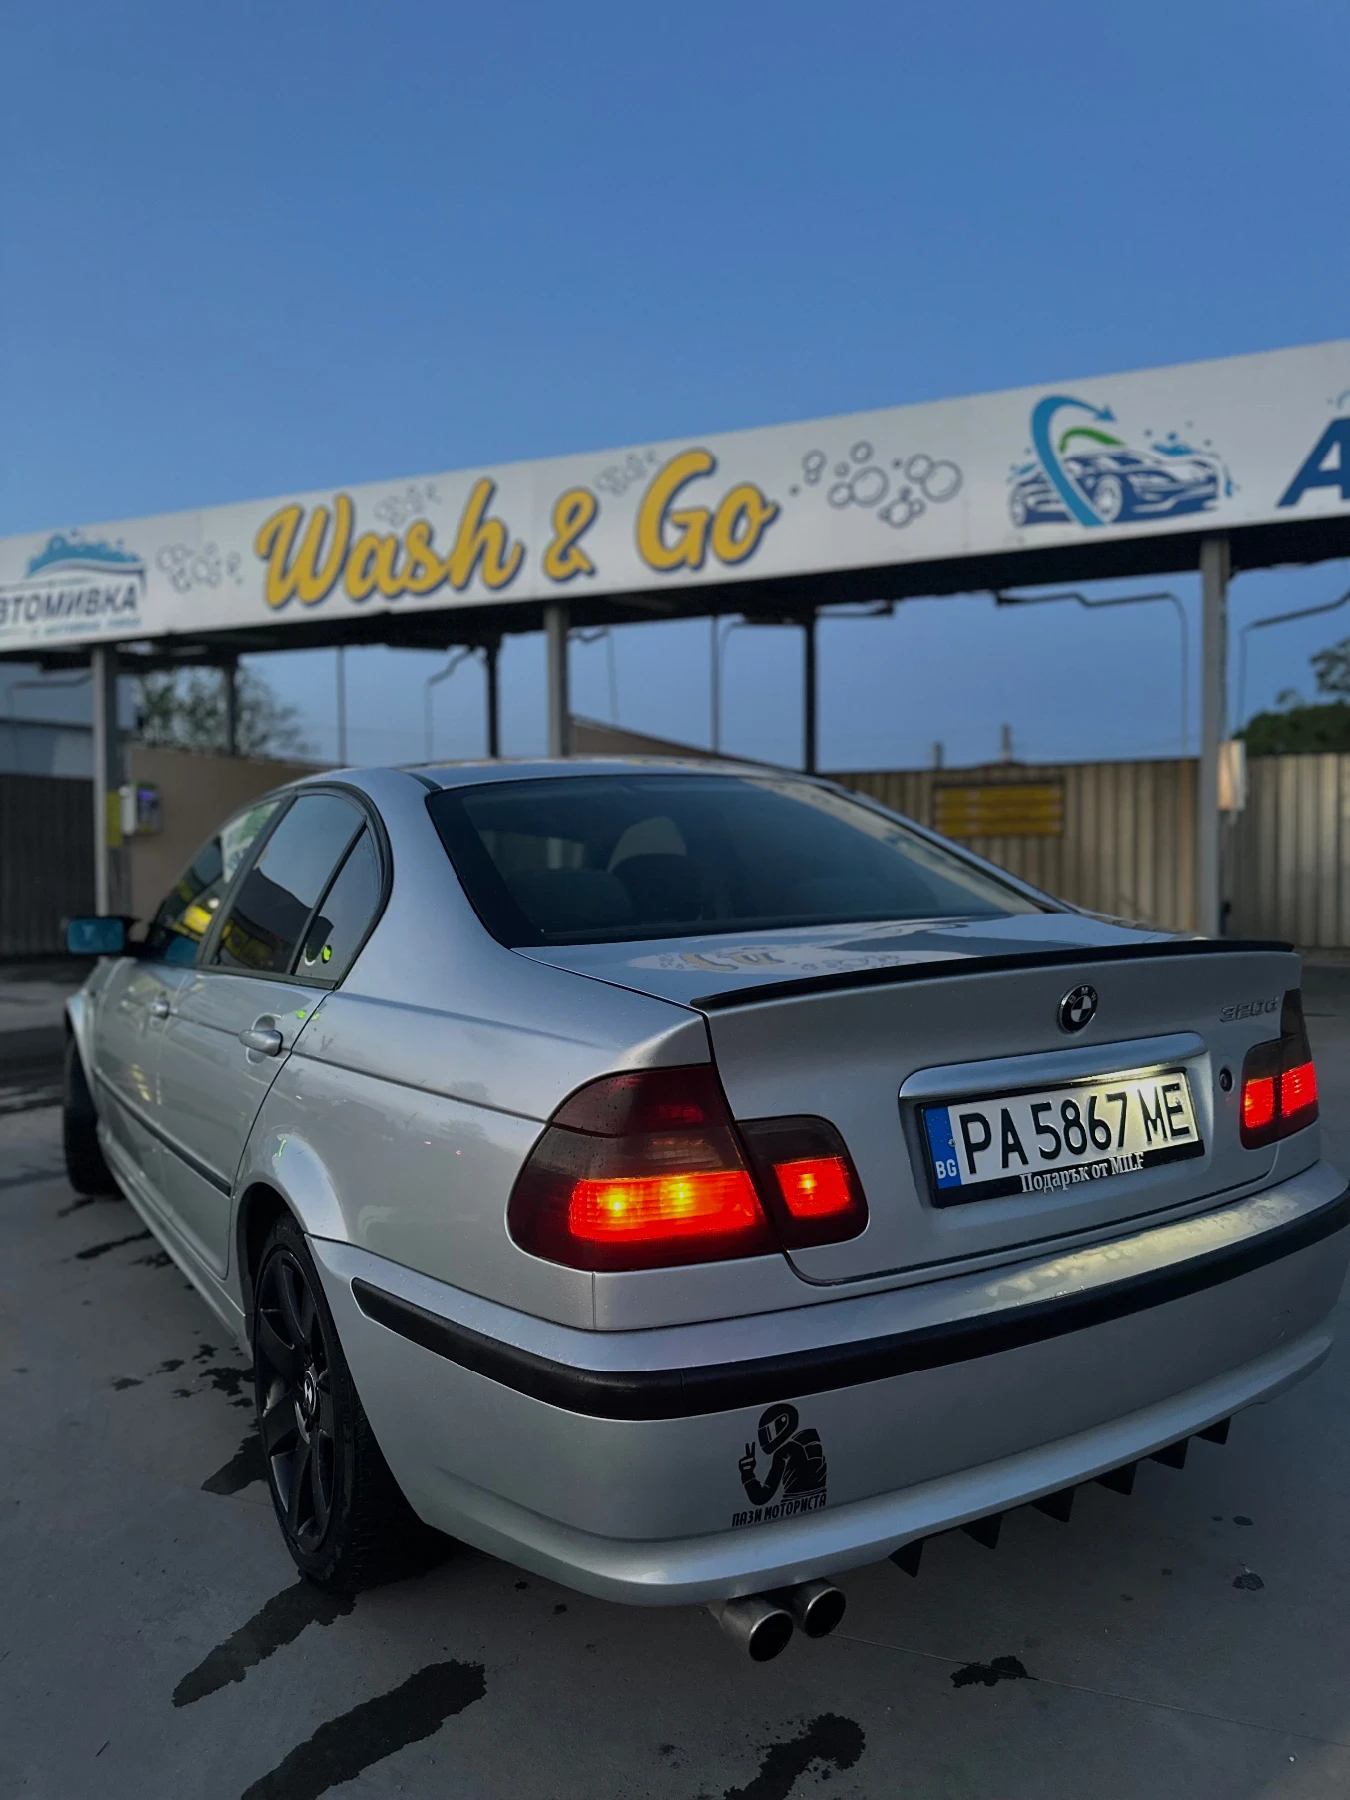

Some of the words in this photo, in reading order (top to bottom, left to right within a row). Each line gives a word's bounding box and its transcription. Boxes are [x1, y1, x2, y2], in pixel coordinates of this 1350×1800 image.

[255, 476, 526, 611] Wash
[543, 488, 597, 581] &
[637, 447, 782, 573] Go
[958, 1107, 1029, 1175] PA
[1030, 1091, 1128, 1161] 5867
[1137, 1082, 1191, 1143] ME
[935, 1159, 958, 1180] BG
[1019, 1166, 1091, 1193] Подарък
[1091, 1162, 1109, 1179] от
[1108, 1151, 1145, 1176] MILF
[732, 1508, 763, 1528] ПАЗИ
[763, 1493, 828, 1521] МОТОРИСТА
